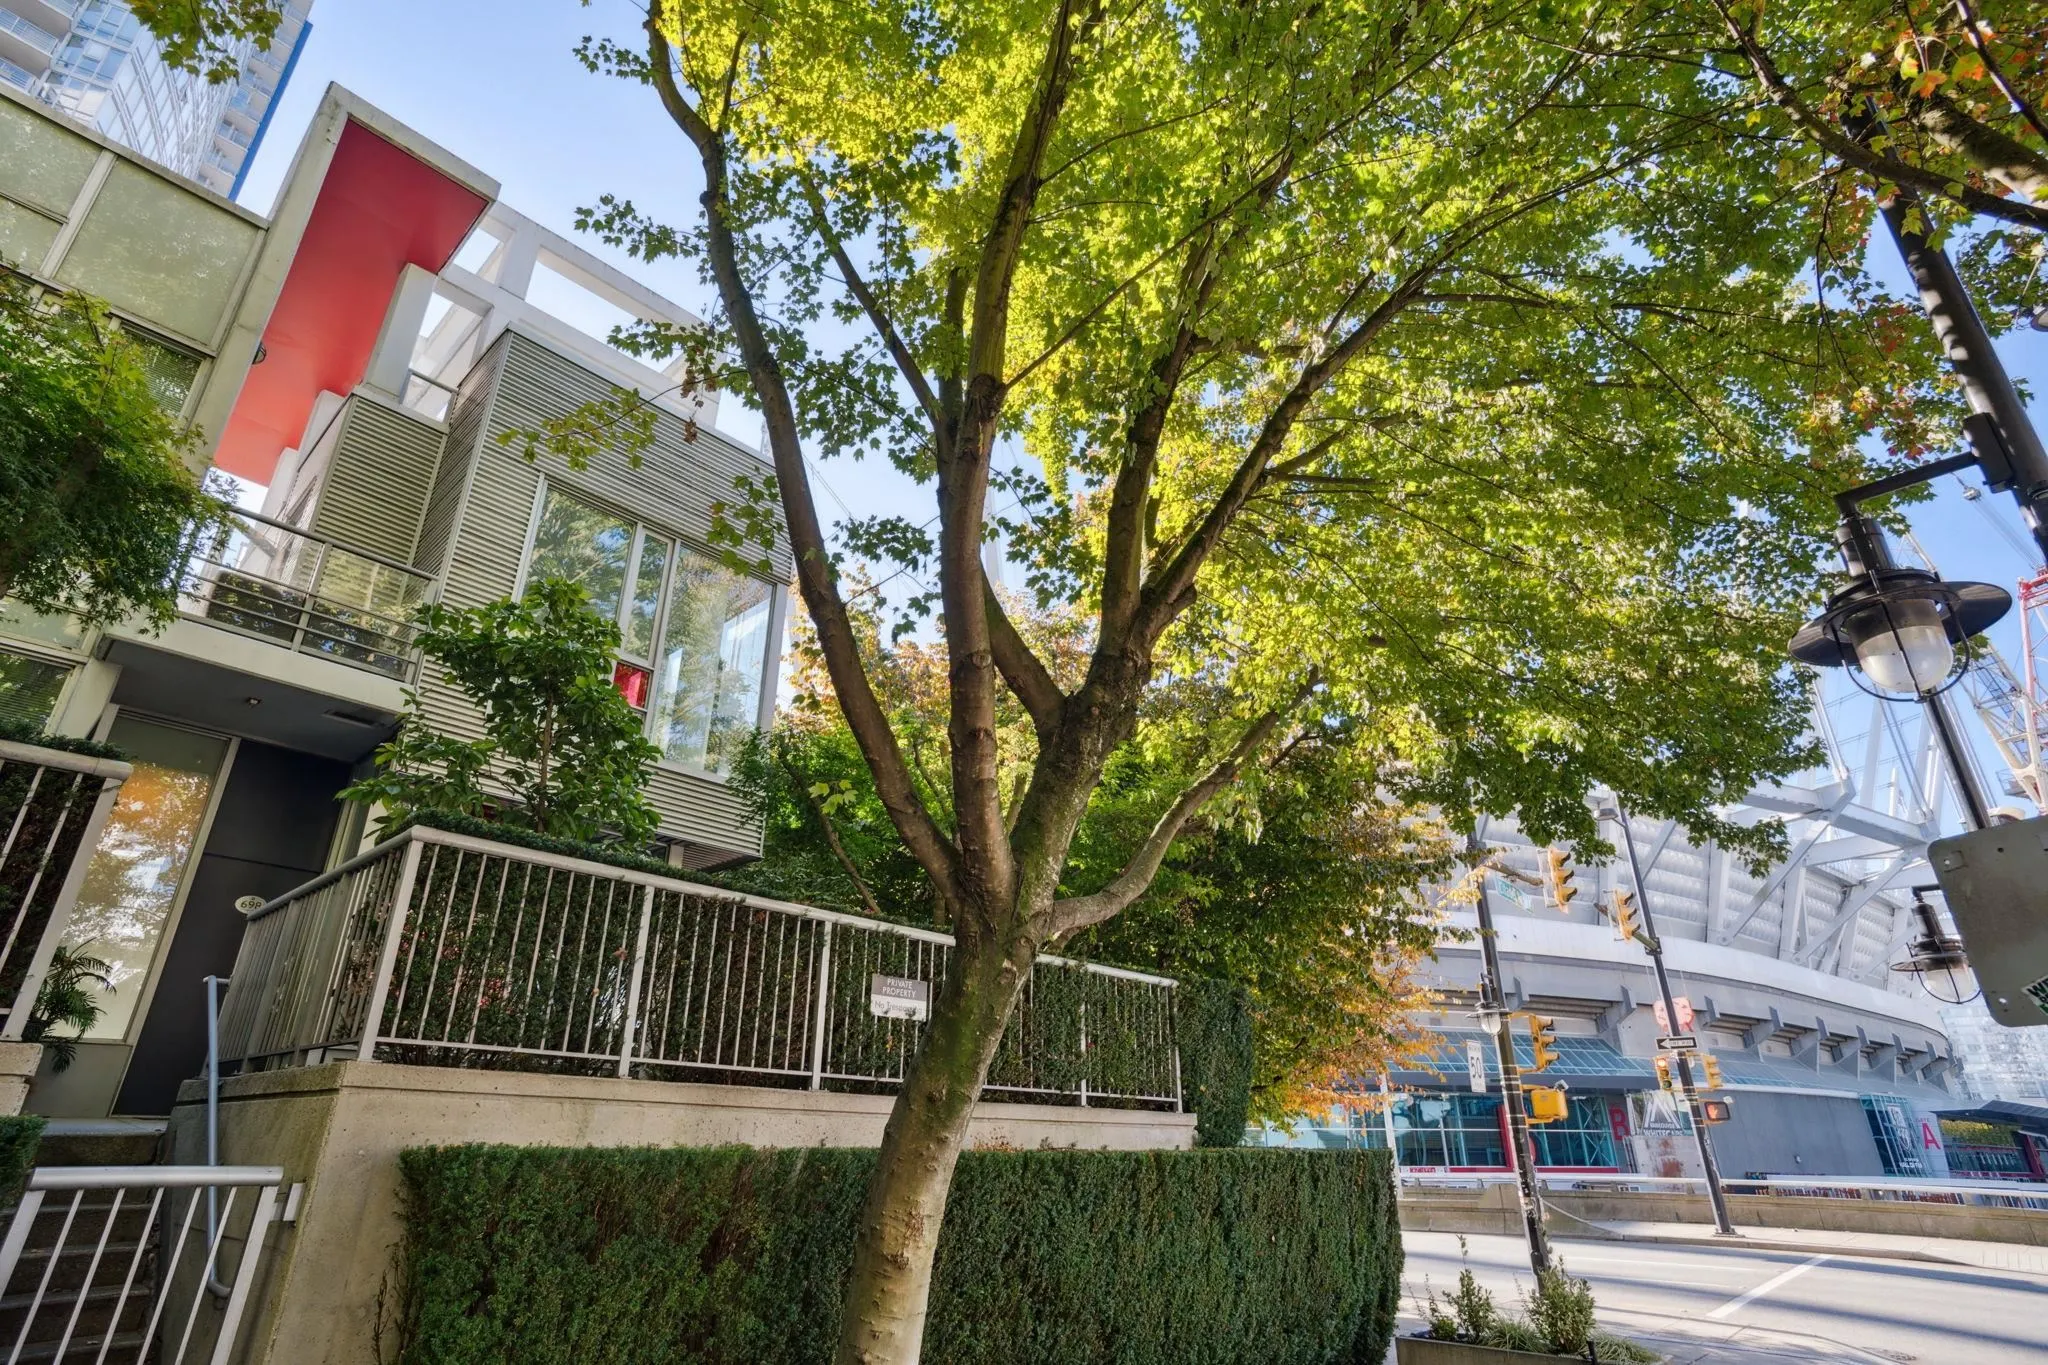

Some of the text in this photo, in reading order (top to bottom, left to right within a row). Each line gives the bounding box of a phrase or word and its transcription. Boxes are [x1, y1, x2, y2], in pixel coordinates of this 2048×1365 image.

[882, 986, 917, 998] PROPERTY
[887, 978, 913, 989] PRIVATE
[874, 1000, 885, 1009] No
[1470, 1056, 1482, 1079] 50
[1610, 1104, 1631, 1141] B
[1921, 1122, 1941, 1150] A
